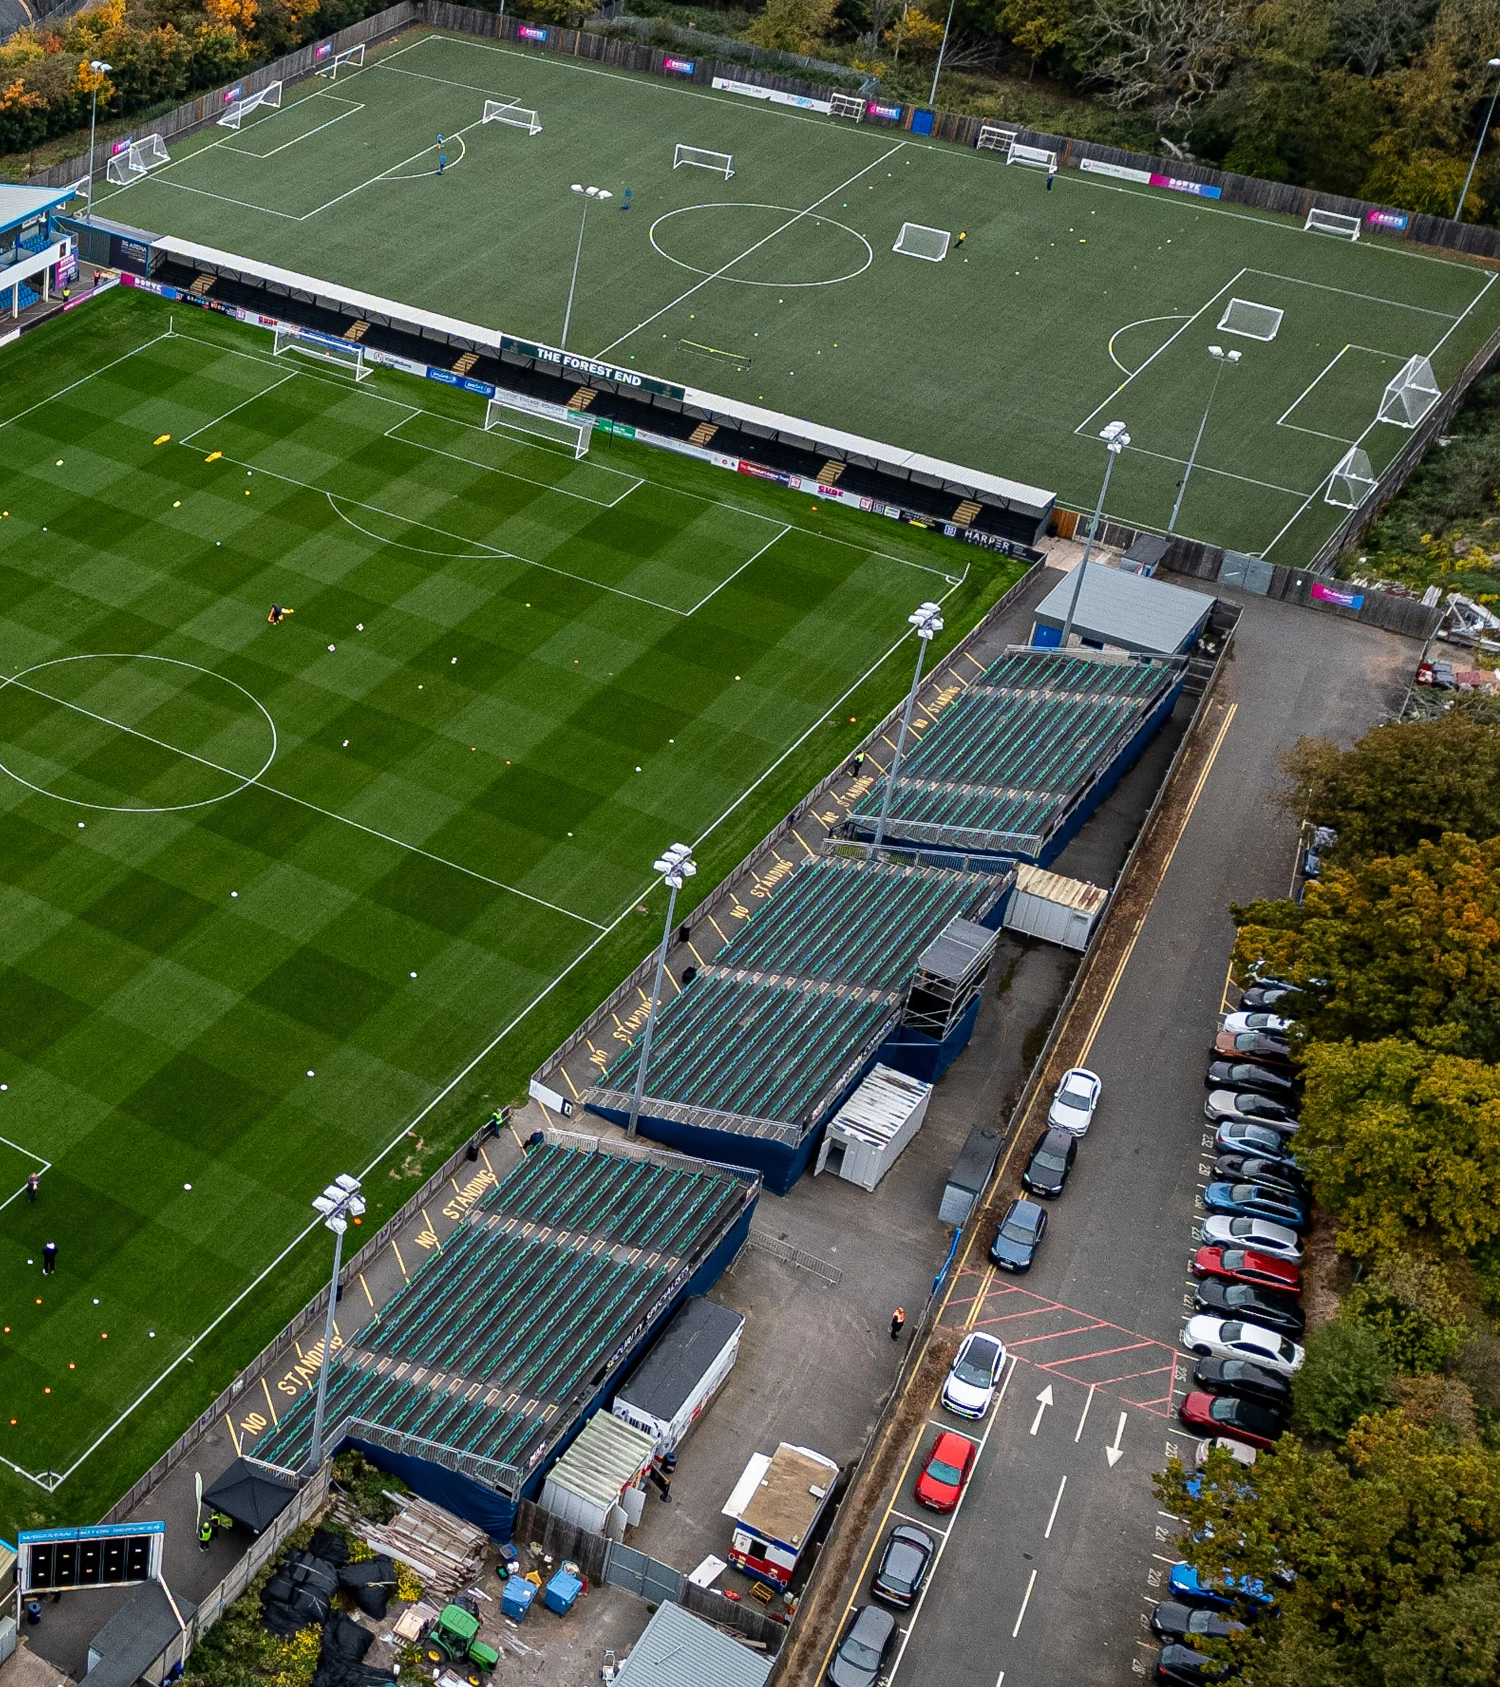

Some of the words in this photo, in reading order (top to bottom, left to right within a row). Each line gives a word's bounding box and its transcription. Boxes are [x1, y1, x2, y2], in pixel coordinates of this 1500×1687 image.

[537, 348, 561, 363] THE
[563, 356, 612, 378] FOREST
[614, 372, 641, 386] END
[965, 529, 1010, 550] HARPER
[730, 904, 750, 919] NO
[751, 859, 794, 899] STANDING
[1201, 1133, 1214, 1148] 232
[1198, 1162, 1211, 1177] 231
[415, 1230, 438, 1250] NO
[443, 1168, 496, 1221] STANDING
[1174, 1364, 1188, 1382] 225
[240, 1411, 267, 1435] NO
[1165, 1441, 1179, 1459] 223
[1147, 1568, 1162, 1588] 220
